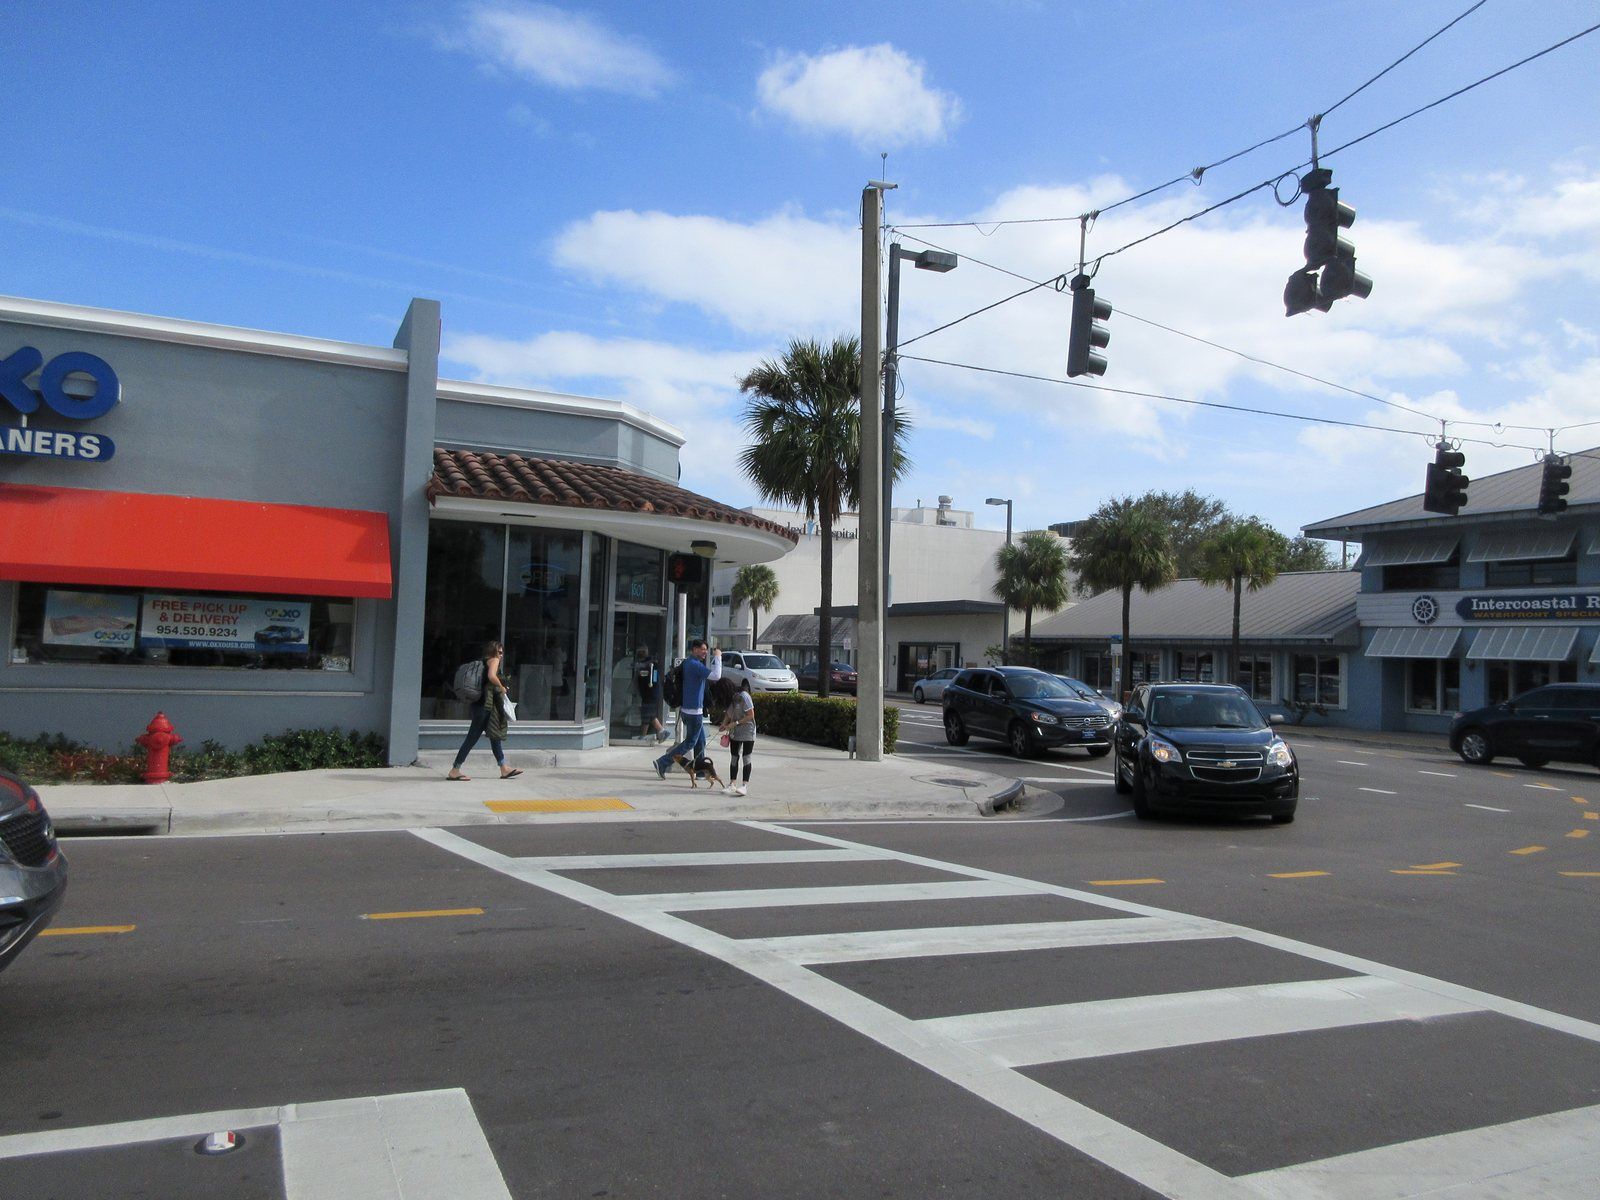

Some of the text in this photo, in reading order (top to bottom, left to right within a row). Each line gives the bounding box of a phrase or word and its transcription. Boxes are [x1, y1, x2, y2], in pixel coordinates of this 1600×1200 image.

[815, 525, 858, 541] Hspital
[152, 600, 249, 614] FREE PICK UP
[1471, 597, 1577, 610] Intercoastal
[159, 612, 240, 625] & DELIVERY
[156, 625, 238, 637] 954.530.9234
[188, 640, 256, 650] www.oxxousa.com
